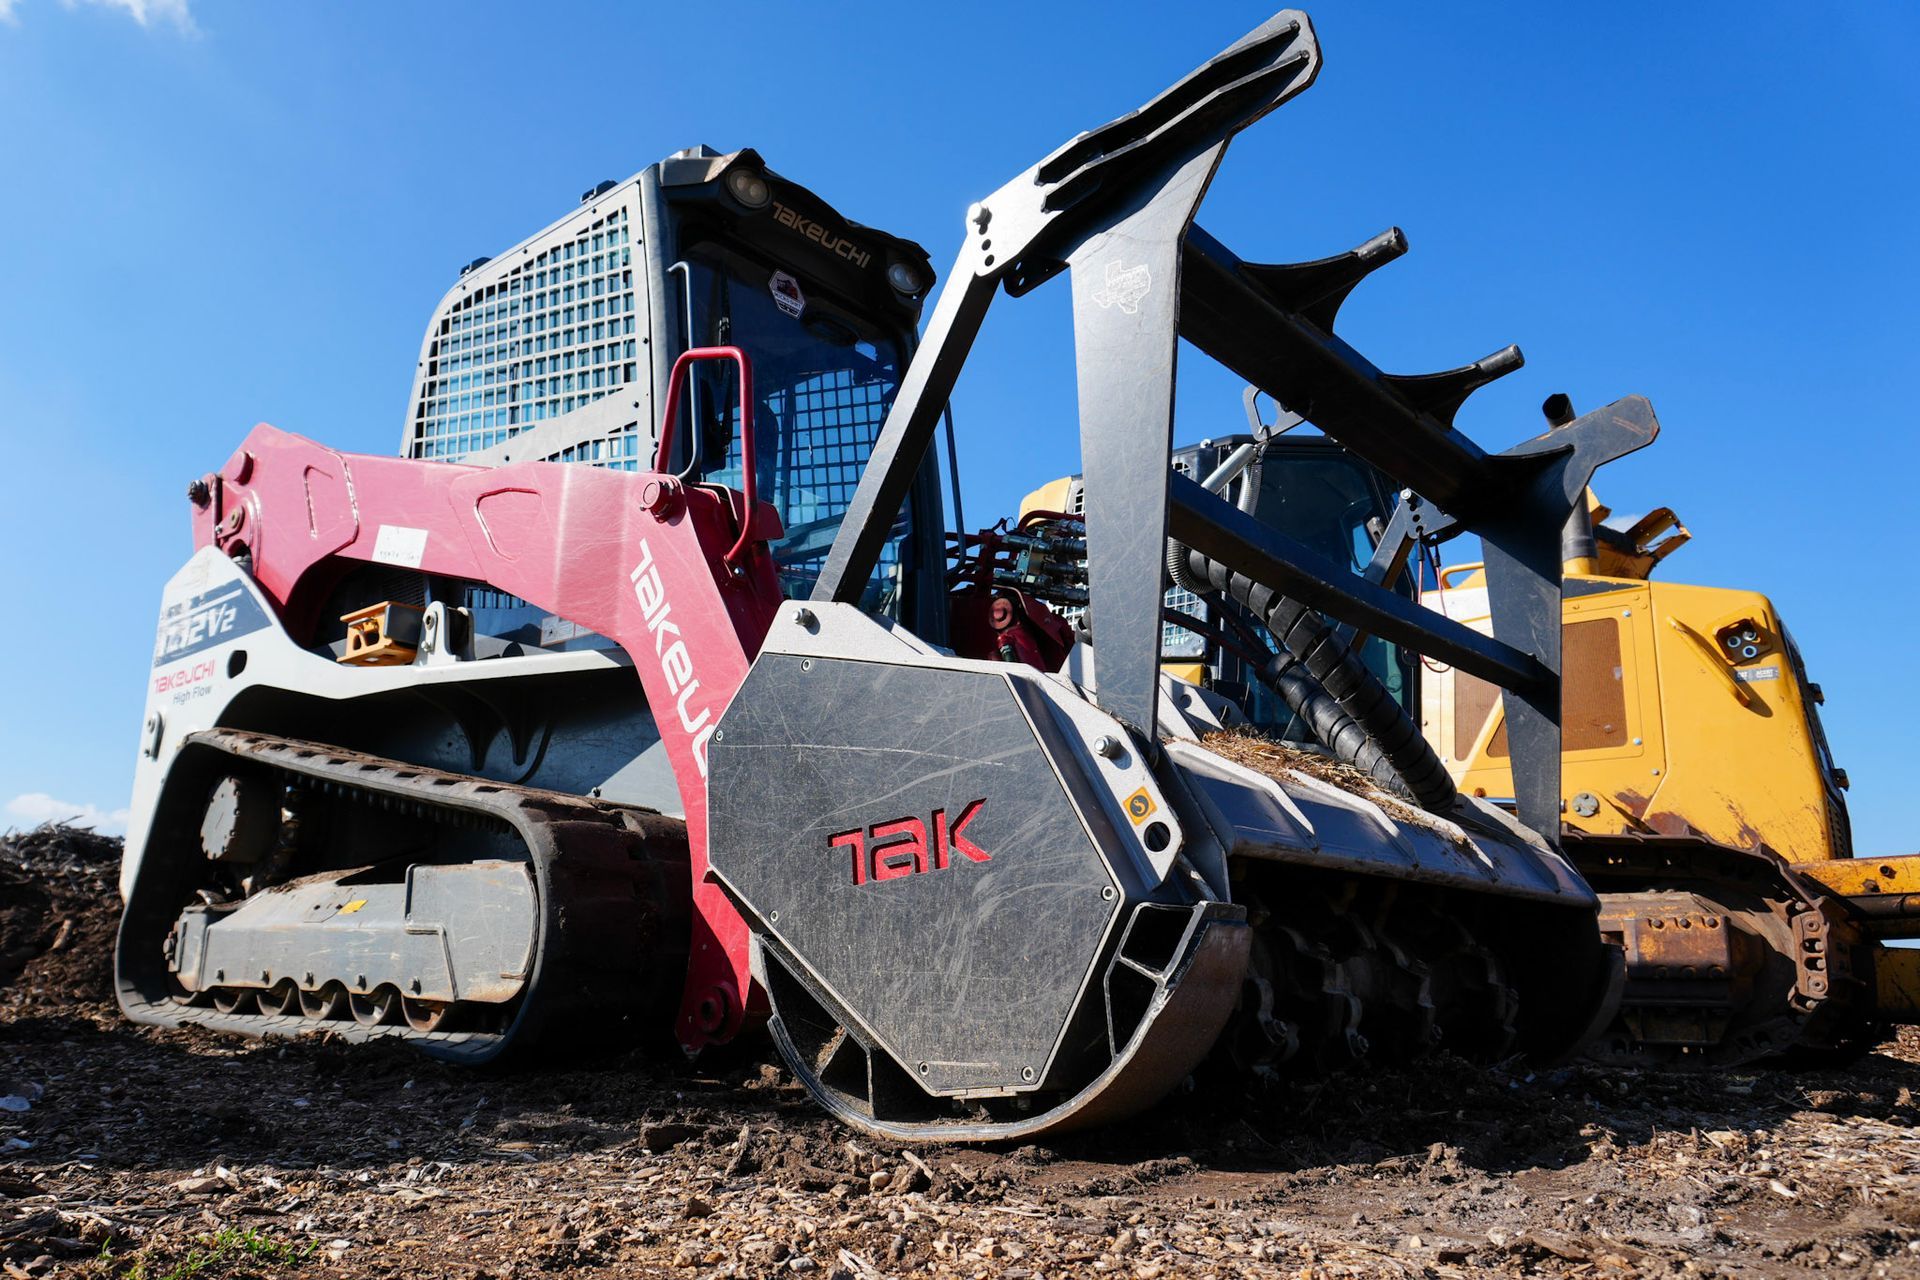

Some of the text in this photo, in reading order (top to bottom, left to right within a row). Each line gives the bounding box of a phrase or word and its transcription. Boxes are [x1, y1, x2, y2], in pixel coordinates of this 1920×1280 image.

[772, 201, 871, 269] TAKEUCHI
[155, 660, 215, 693] TAKEUCHI
[173, 685, 213, 705] High Flow
[630, 537, 715, 792] TAKEUC
[827, 797, 993, 886] TAK
